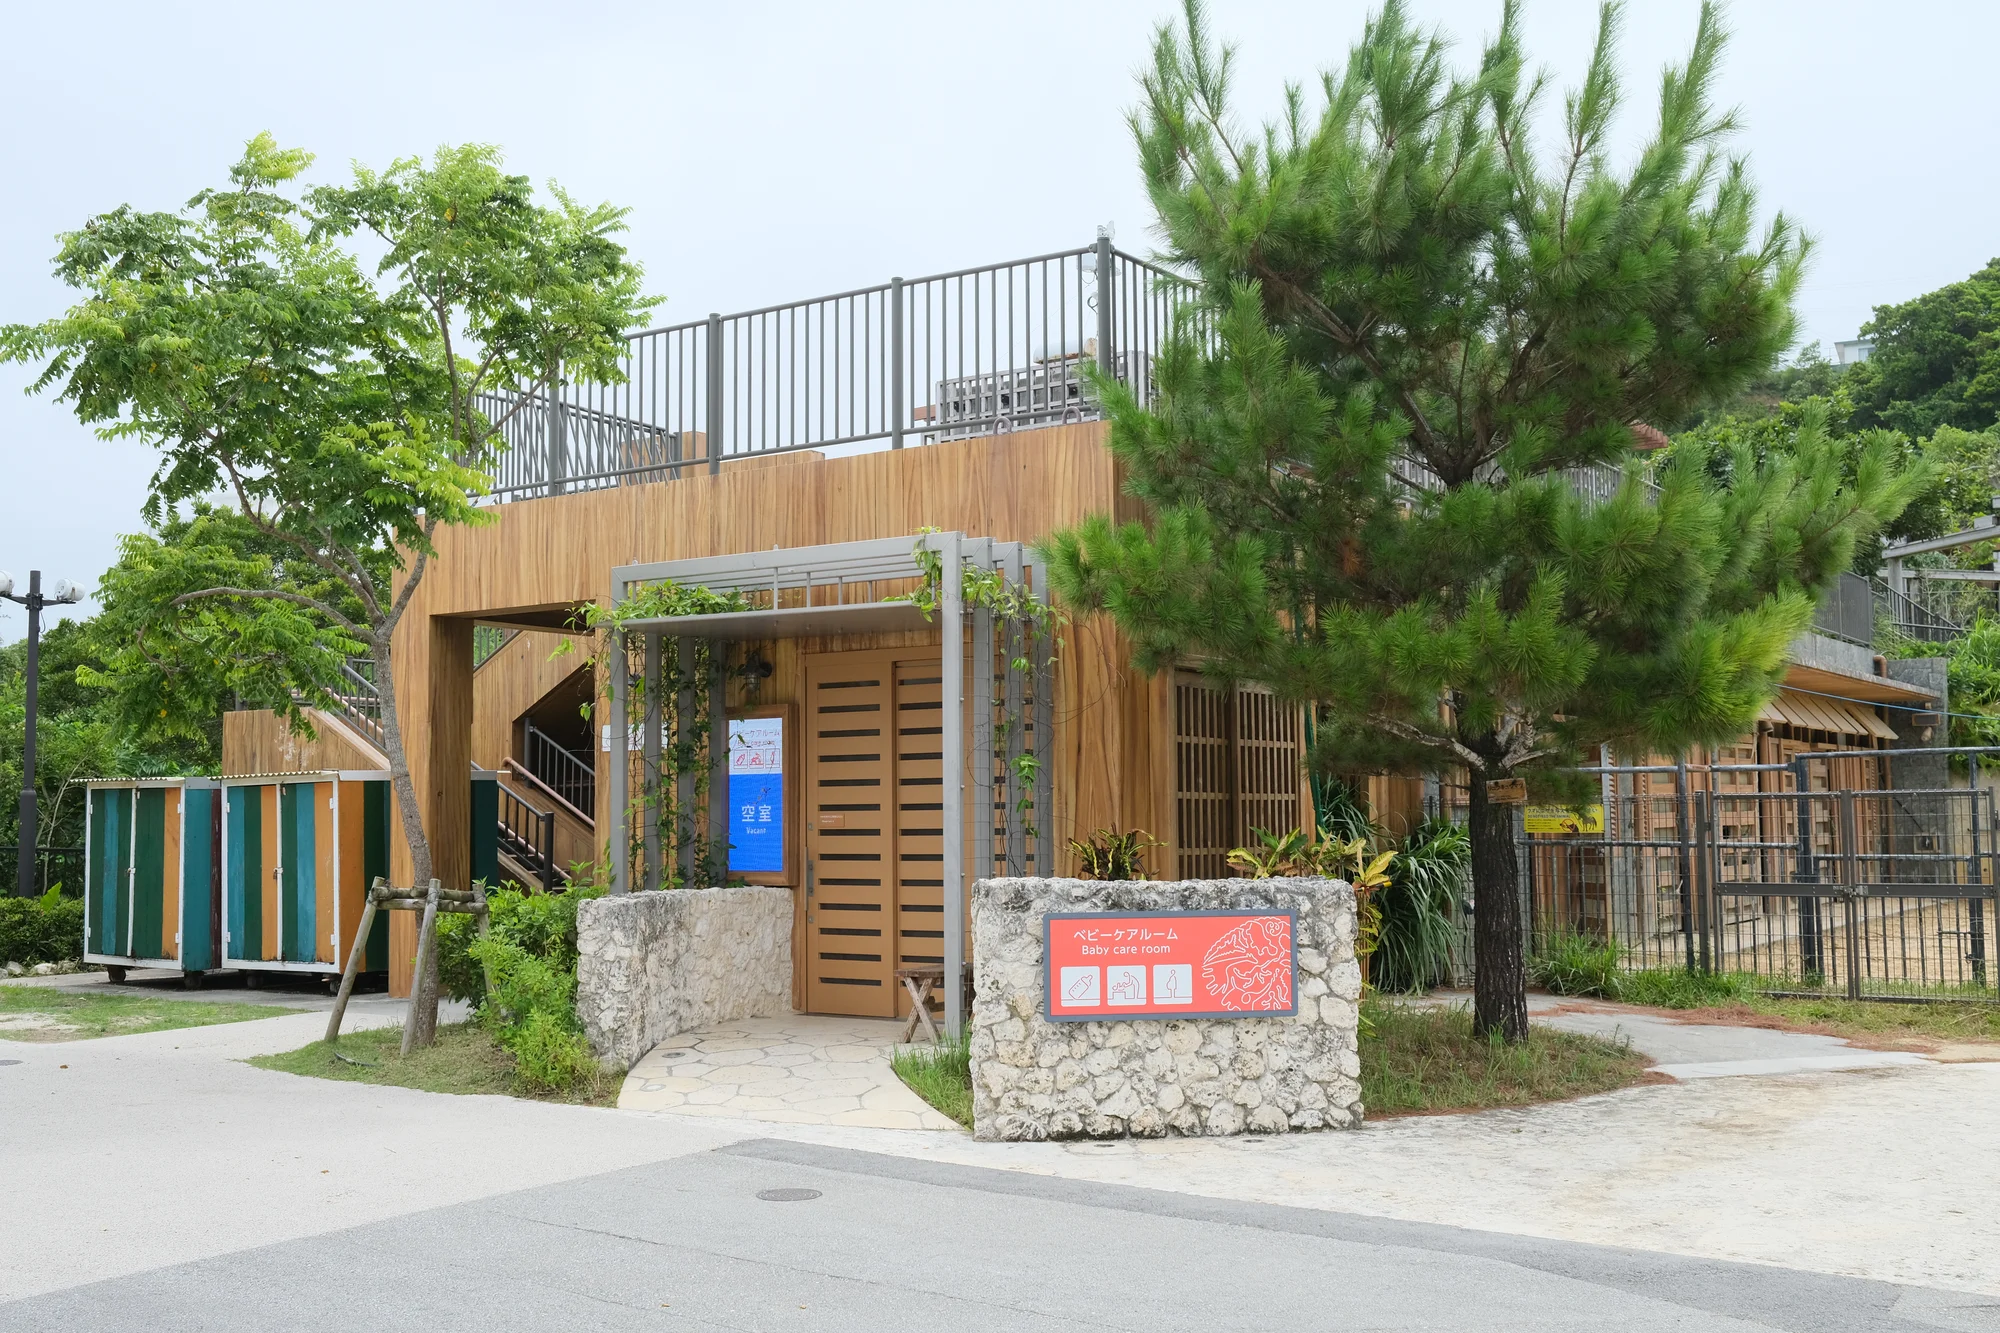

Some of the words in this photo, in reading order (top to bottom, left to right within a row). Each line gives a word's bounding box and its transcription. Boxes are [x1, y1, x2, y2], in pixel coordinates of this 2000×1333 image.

[741, 804, 772, 822] 空室
[746, 826, 767, 834] Vacant
[1073, 928, 1178, 941] ベビーケアルーム
[1081, 945, 1110, 955] Baby
[1113, 945, 1138, 954] care
[1141, 945, 1171, 954] room
